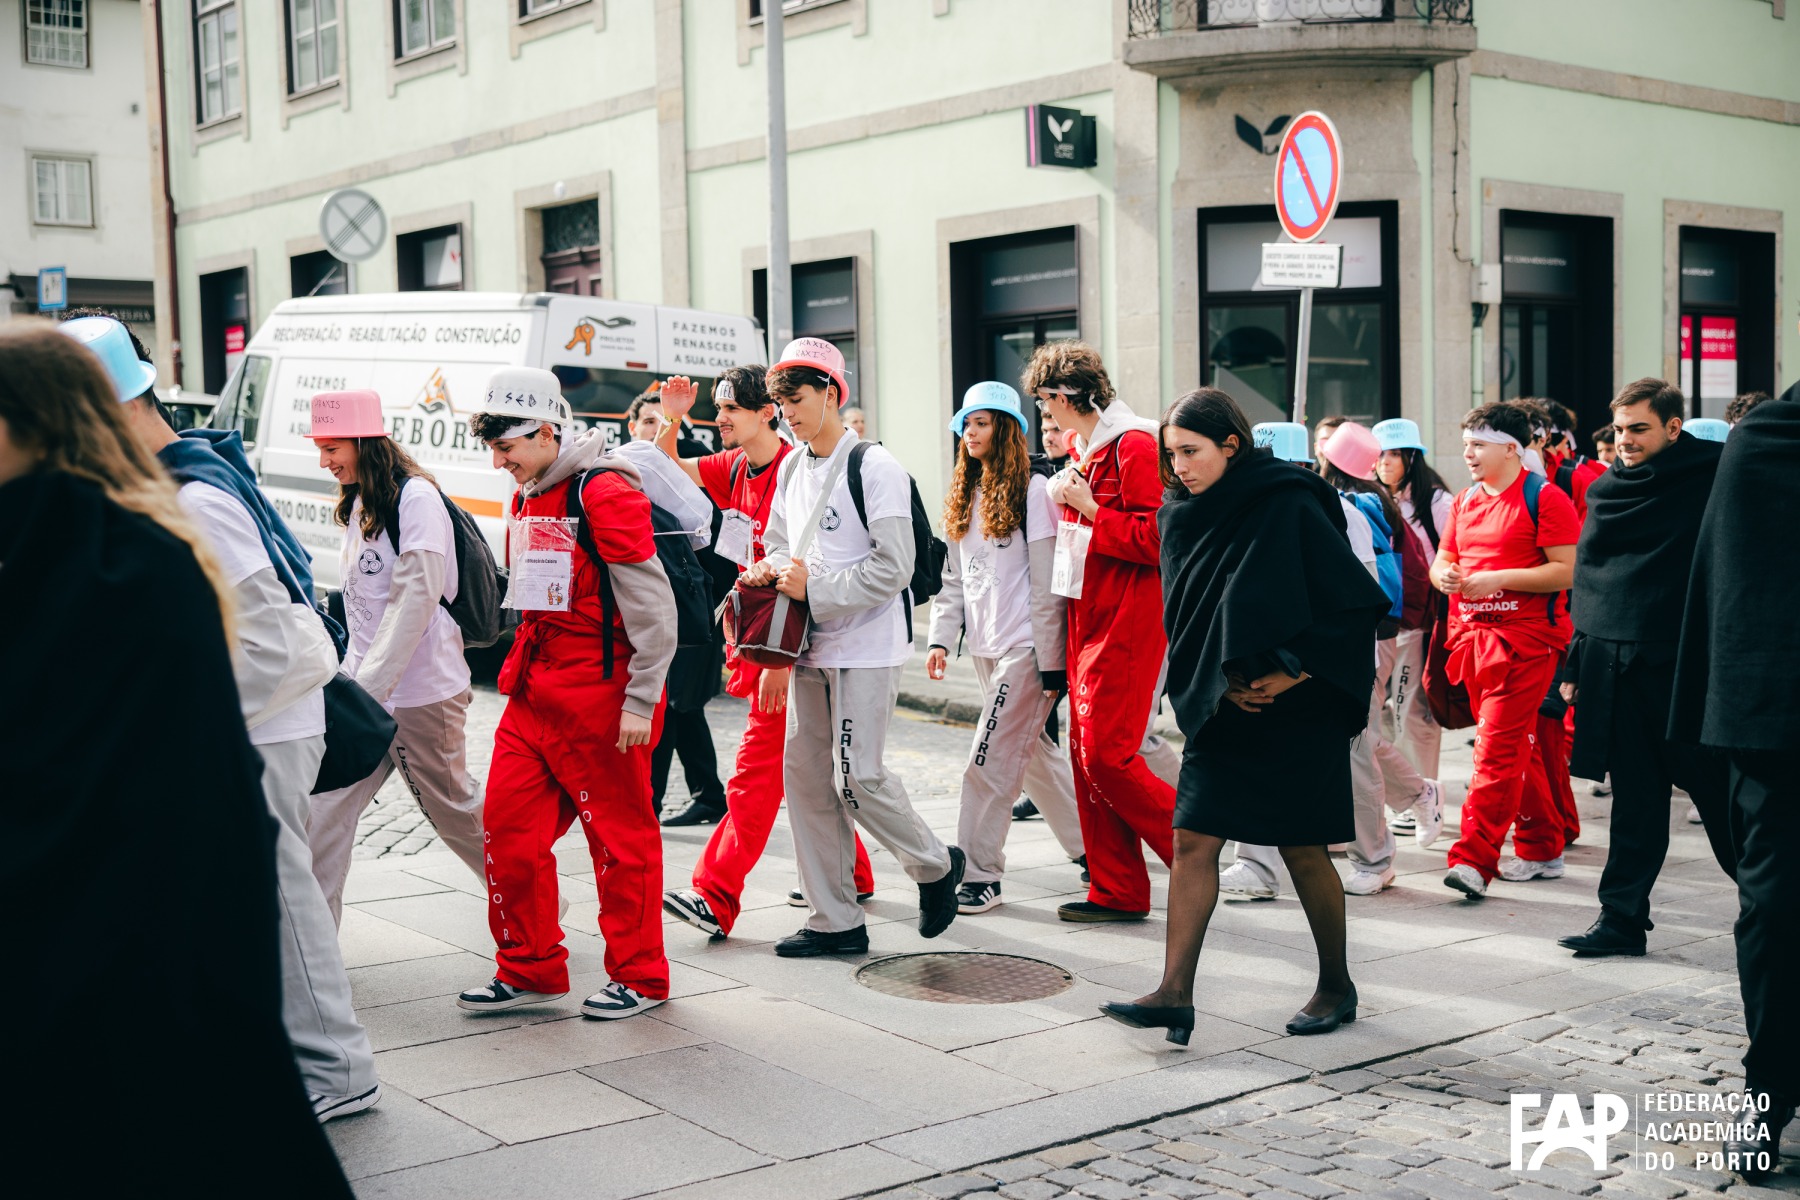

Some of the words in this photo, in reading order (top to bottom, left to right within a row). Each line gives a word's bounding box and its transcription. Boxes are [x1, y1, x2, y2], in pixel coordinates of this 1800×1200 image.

[274, 322, 342, 343] RECUPERAÇÃO
[349, 322, 427, 345] REABILITAÇÃO
[435, 322, 522, 347] CONSTRUÇÃO
[672, 321, 736, 338] FAZEMOS
[673, 338, 736, 353] RENASCER
[674, 354, 682, 363] A
[685, 354, 706, 366] SUA
[708, 357, 736, 368] CASA
[296, 375, 347, 391] FAZEMOS
[296, 502, 316, 522] 010
[975, 683, 1010, 766] CALOIRO
